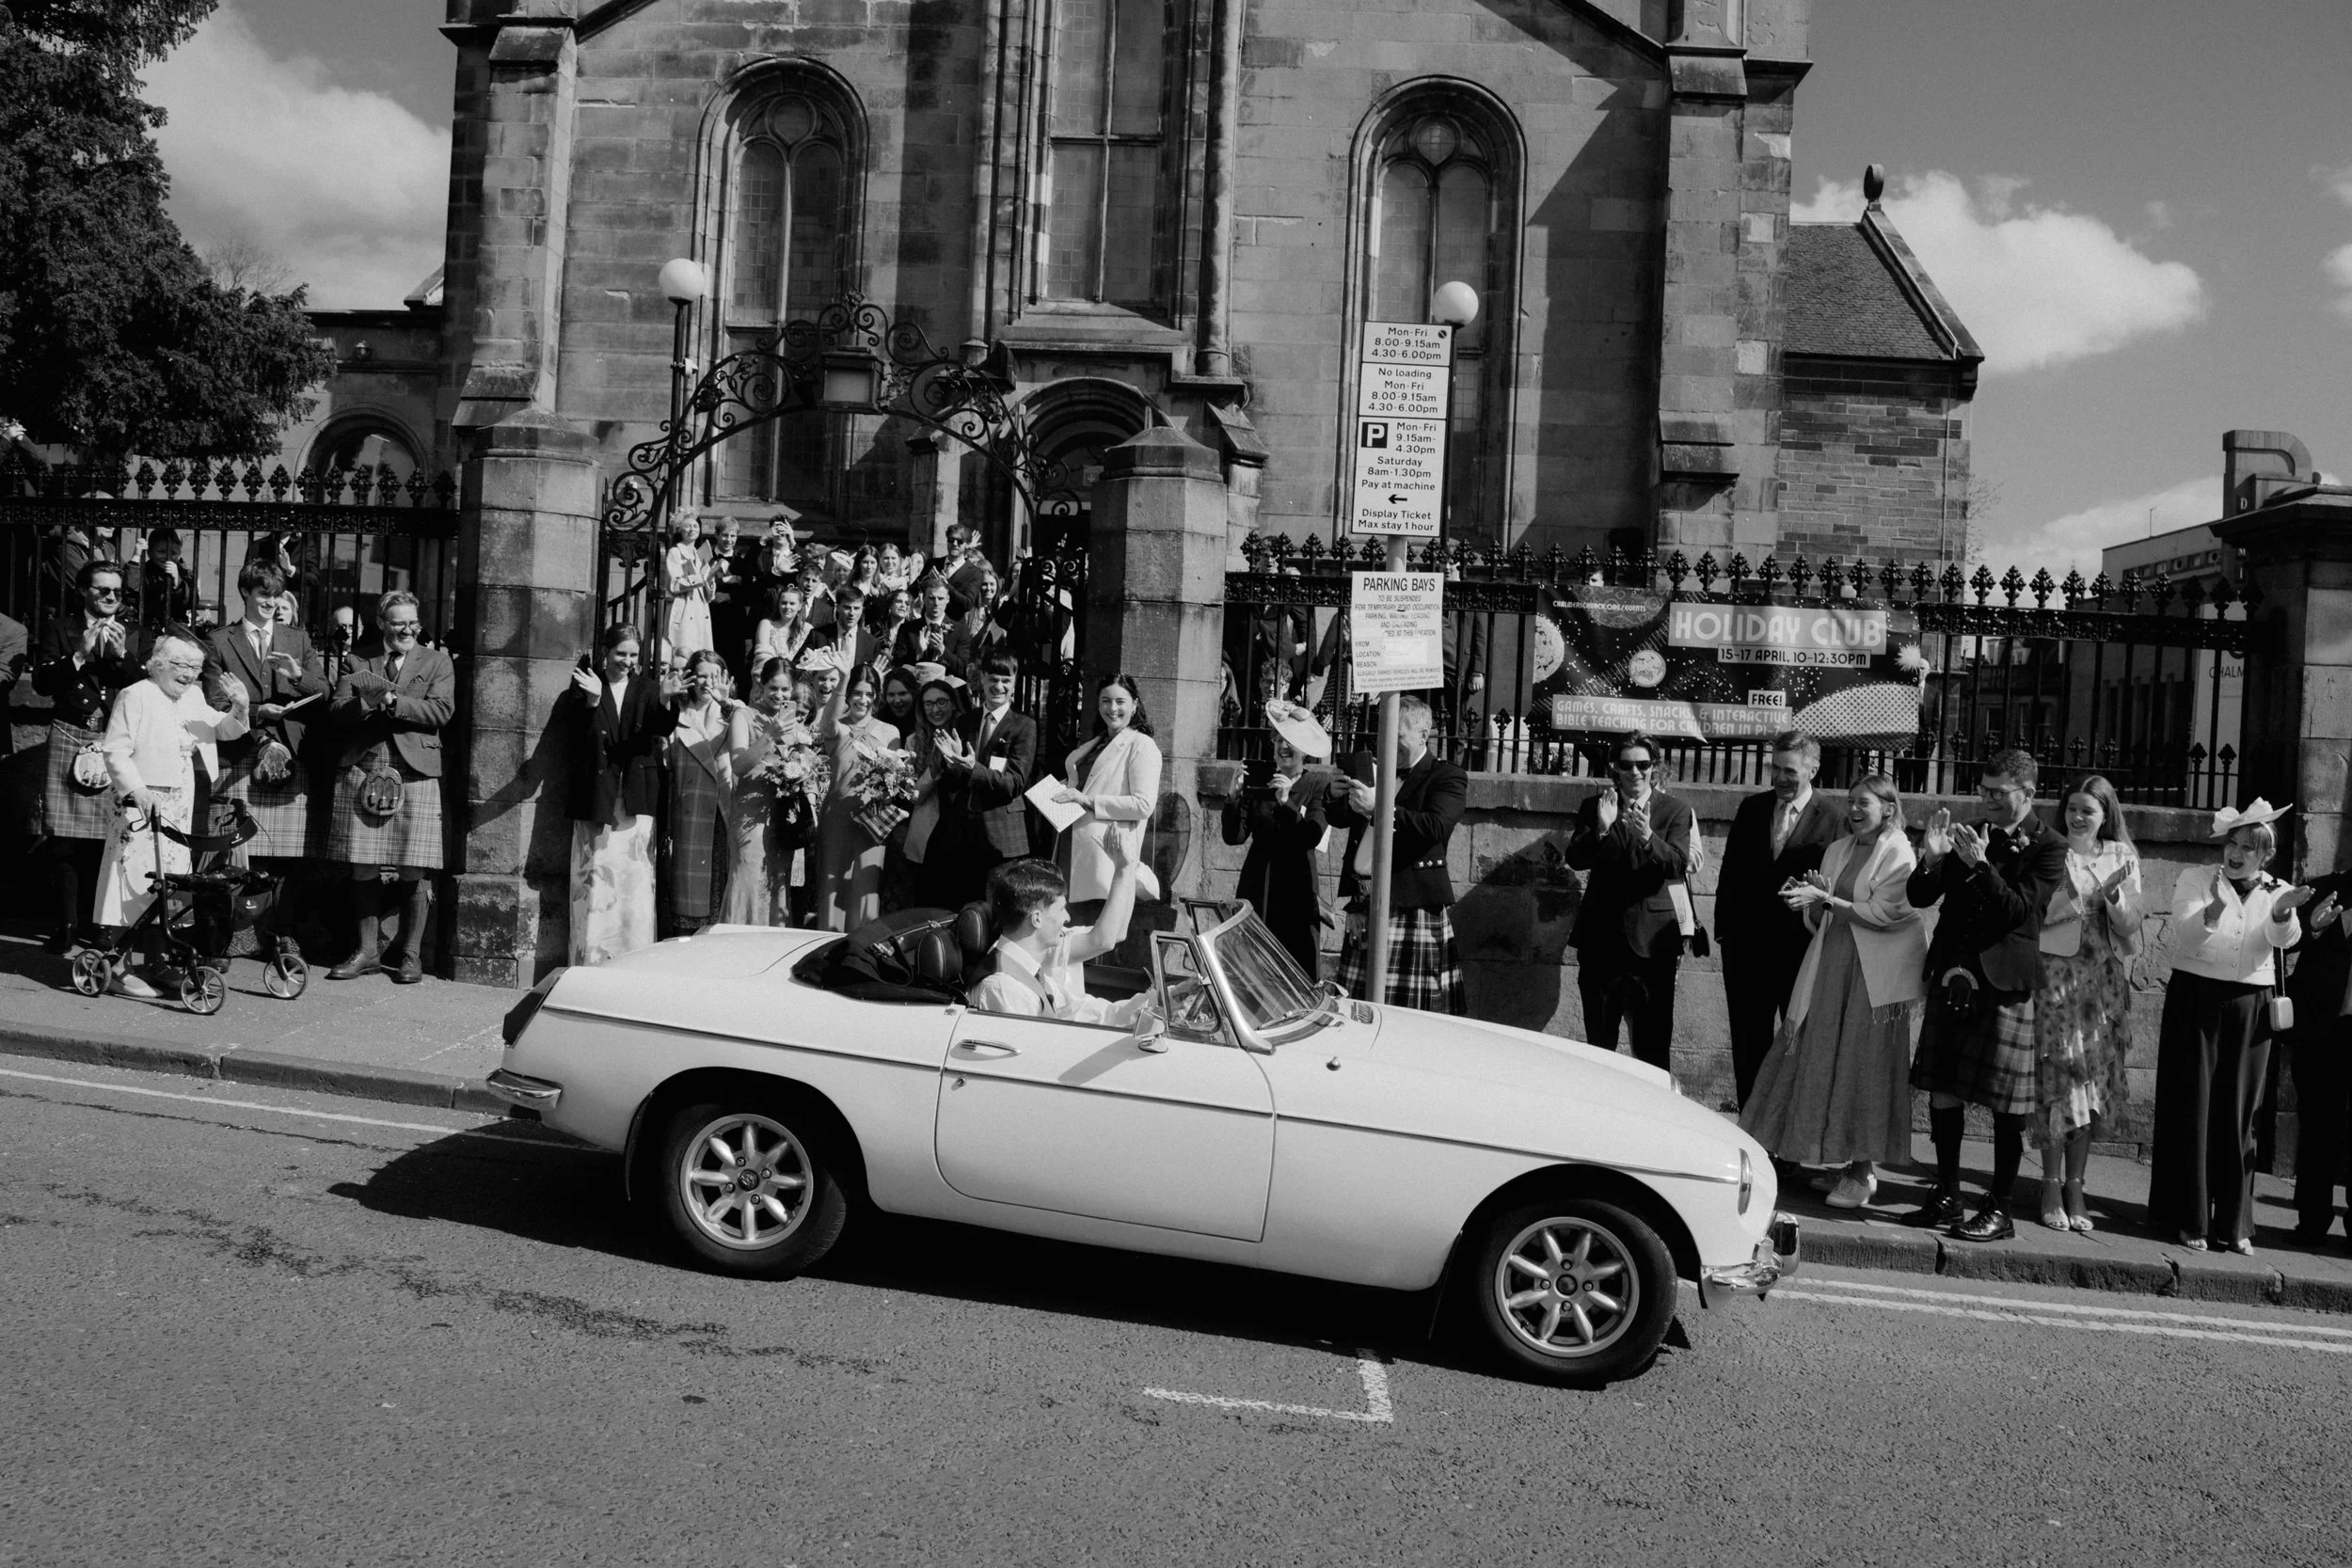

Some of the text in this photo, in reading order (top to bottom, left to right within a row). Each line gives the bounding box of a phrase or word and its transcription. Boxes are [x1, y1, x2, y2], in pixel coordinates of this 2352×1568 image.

[1378, 368, 1432, 379] No loading
[1367, 424, 1385, 447] P
[1395, 445, 1436, 454] 4.30pm
[1377, 456, 1422, 467] Saturday
[1361, 480, 1379, 490] Pay
[1393, 482, 1436, 490] machine
[1362, 509, 1431, 520] Display Ticket
[1359, 520, 1378, 529] Max
[1381, 522, 1402, 531] stay
[1411, 523, 1434, 531] hour
[1363, 578, 1436, 591] PARKING BAYS
[1675, 611, 1882, 647] HOLIDAY CLUB
[1720, 648, 1752, 660] 15-17
[1793, 651, 1867, 666] 10-12:30PM
[1752, 693, 1783, 706] FREE!
[1557, 700, 1598, 714] GAMES,
[1602, 703, 1645, 717] CRAFTS,
[1699, 708, 1708, 721] &
[1712, 708, 1788, 723] INTERACTIVE
[1556, 714, 1588, 726] BIBLE
[1591, 716, 1646, 730] TEACHING
[1650, 719, 1676, 731] FOR
[1678, 720, 1735, 735] CHILDREN
[1739, 723, 1751, 736] IN
